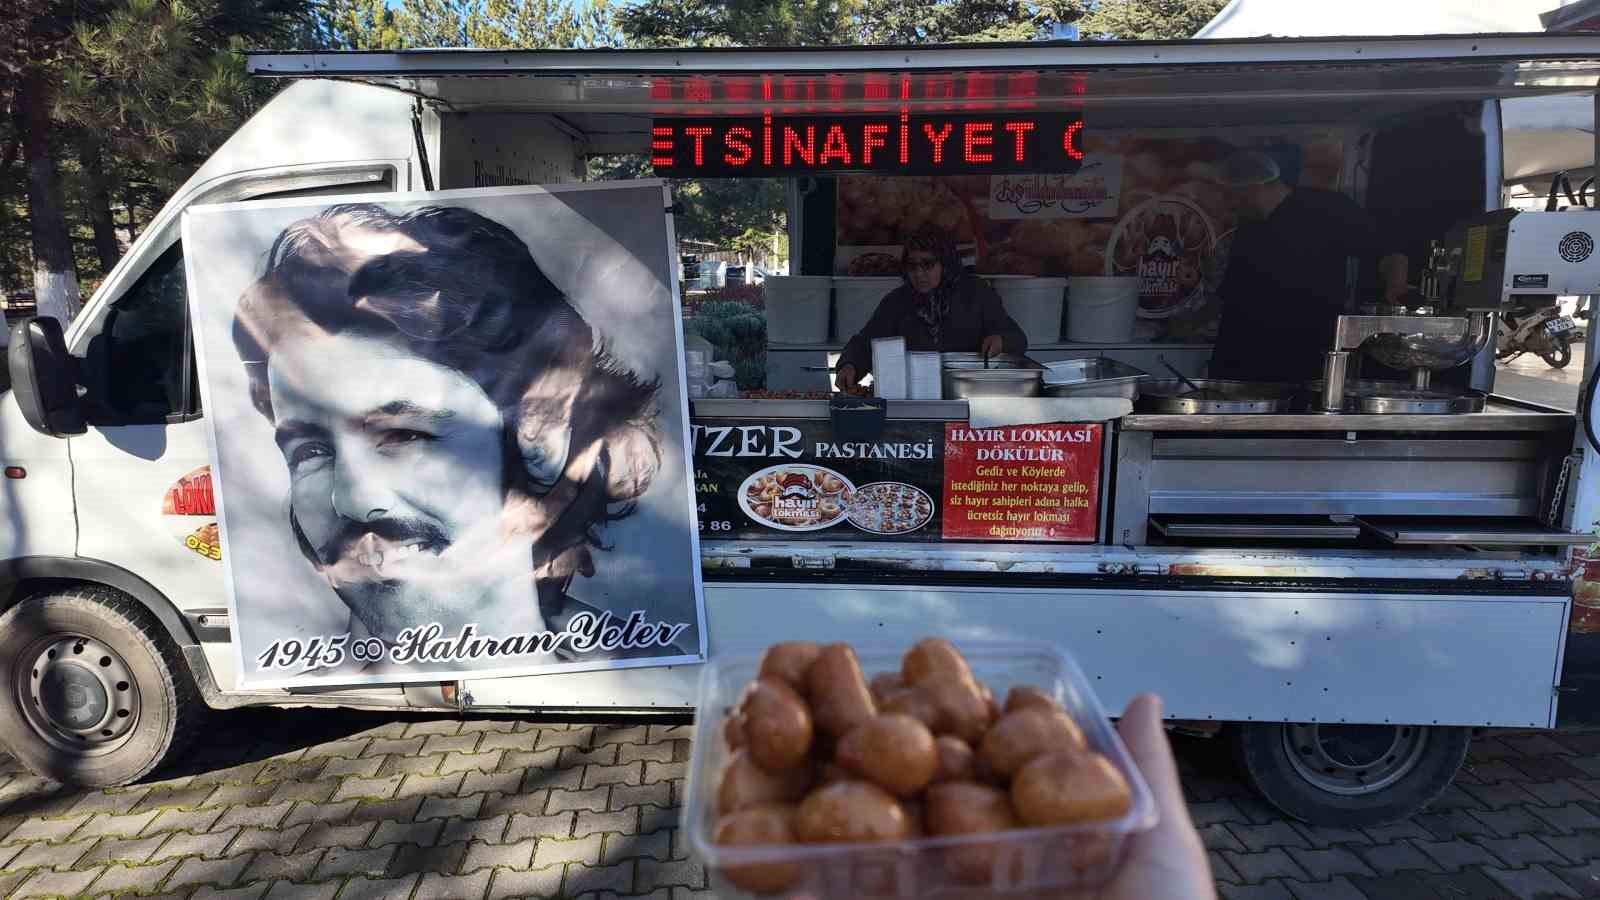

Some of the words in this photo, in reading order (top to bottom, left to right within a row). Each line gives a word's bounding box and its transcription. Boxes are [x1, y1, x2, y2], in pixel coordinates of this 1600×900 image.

[951, 429, 1005, 442] HAYIR
[815, 438, 935, 460] PASTANESİ
[976, 445, 1064, 461] DÖKÜLÜR
[976, 465, 1003, 477] Gediz
[1007, 468, 1018, 477] ve
[1021, 465, 1066, 478] Köylerde
[951, 480, 999, 492] istediğiniz
[1001, 480, 1017, 491] her
[1021, 481, 1059, 493] noktaya
[1062, 481, 1089, 494] gelip,
[950, 495, 962, 505] siz
[965, 495, 989, 507] hayır
[991, 495, 1032, 507] sahipleri
[1035, 496, 1060, 506] adına
[1063, 496, 1089, 507] halka
[967, 510, 1003, 521] ücretsiz
[1006, 510, 1031, 522] hayır
[1034, 511, 1070, 522] lokması
[710, 520, 732, 531] 86
[257, 636, 349, 668] 1945
[393, 624, 562, 662] Hatıran
[568, 611, 688, 650] Yeter
